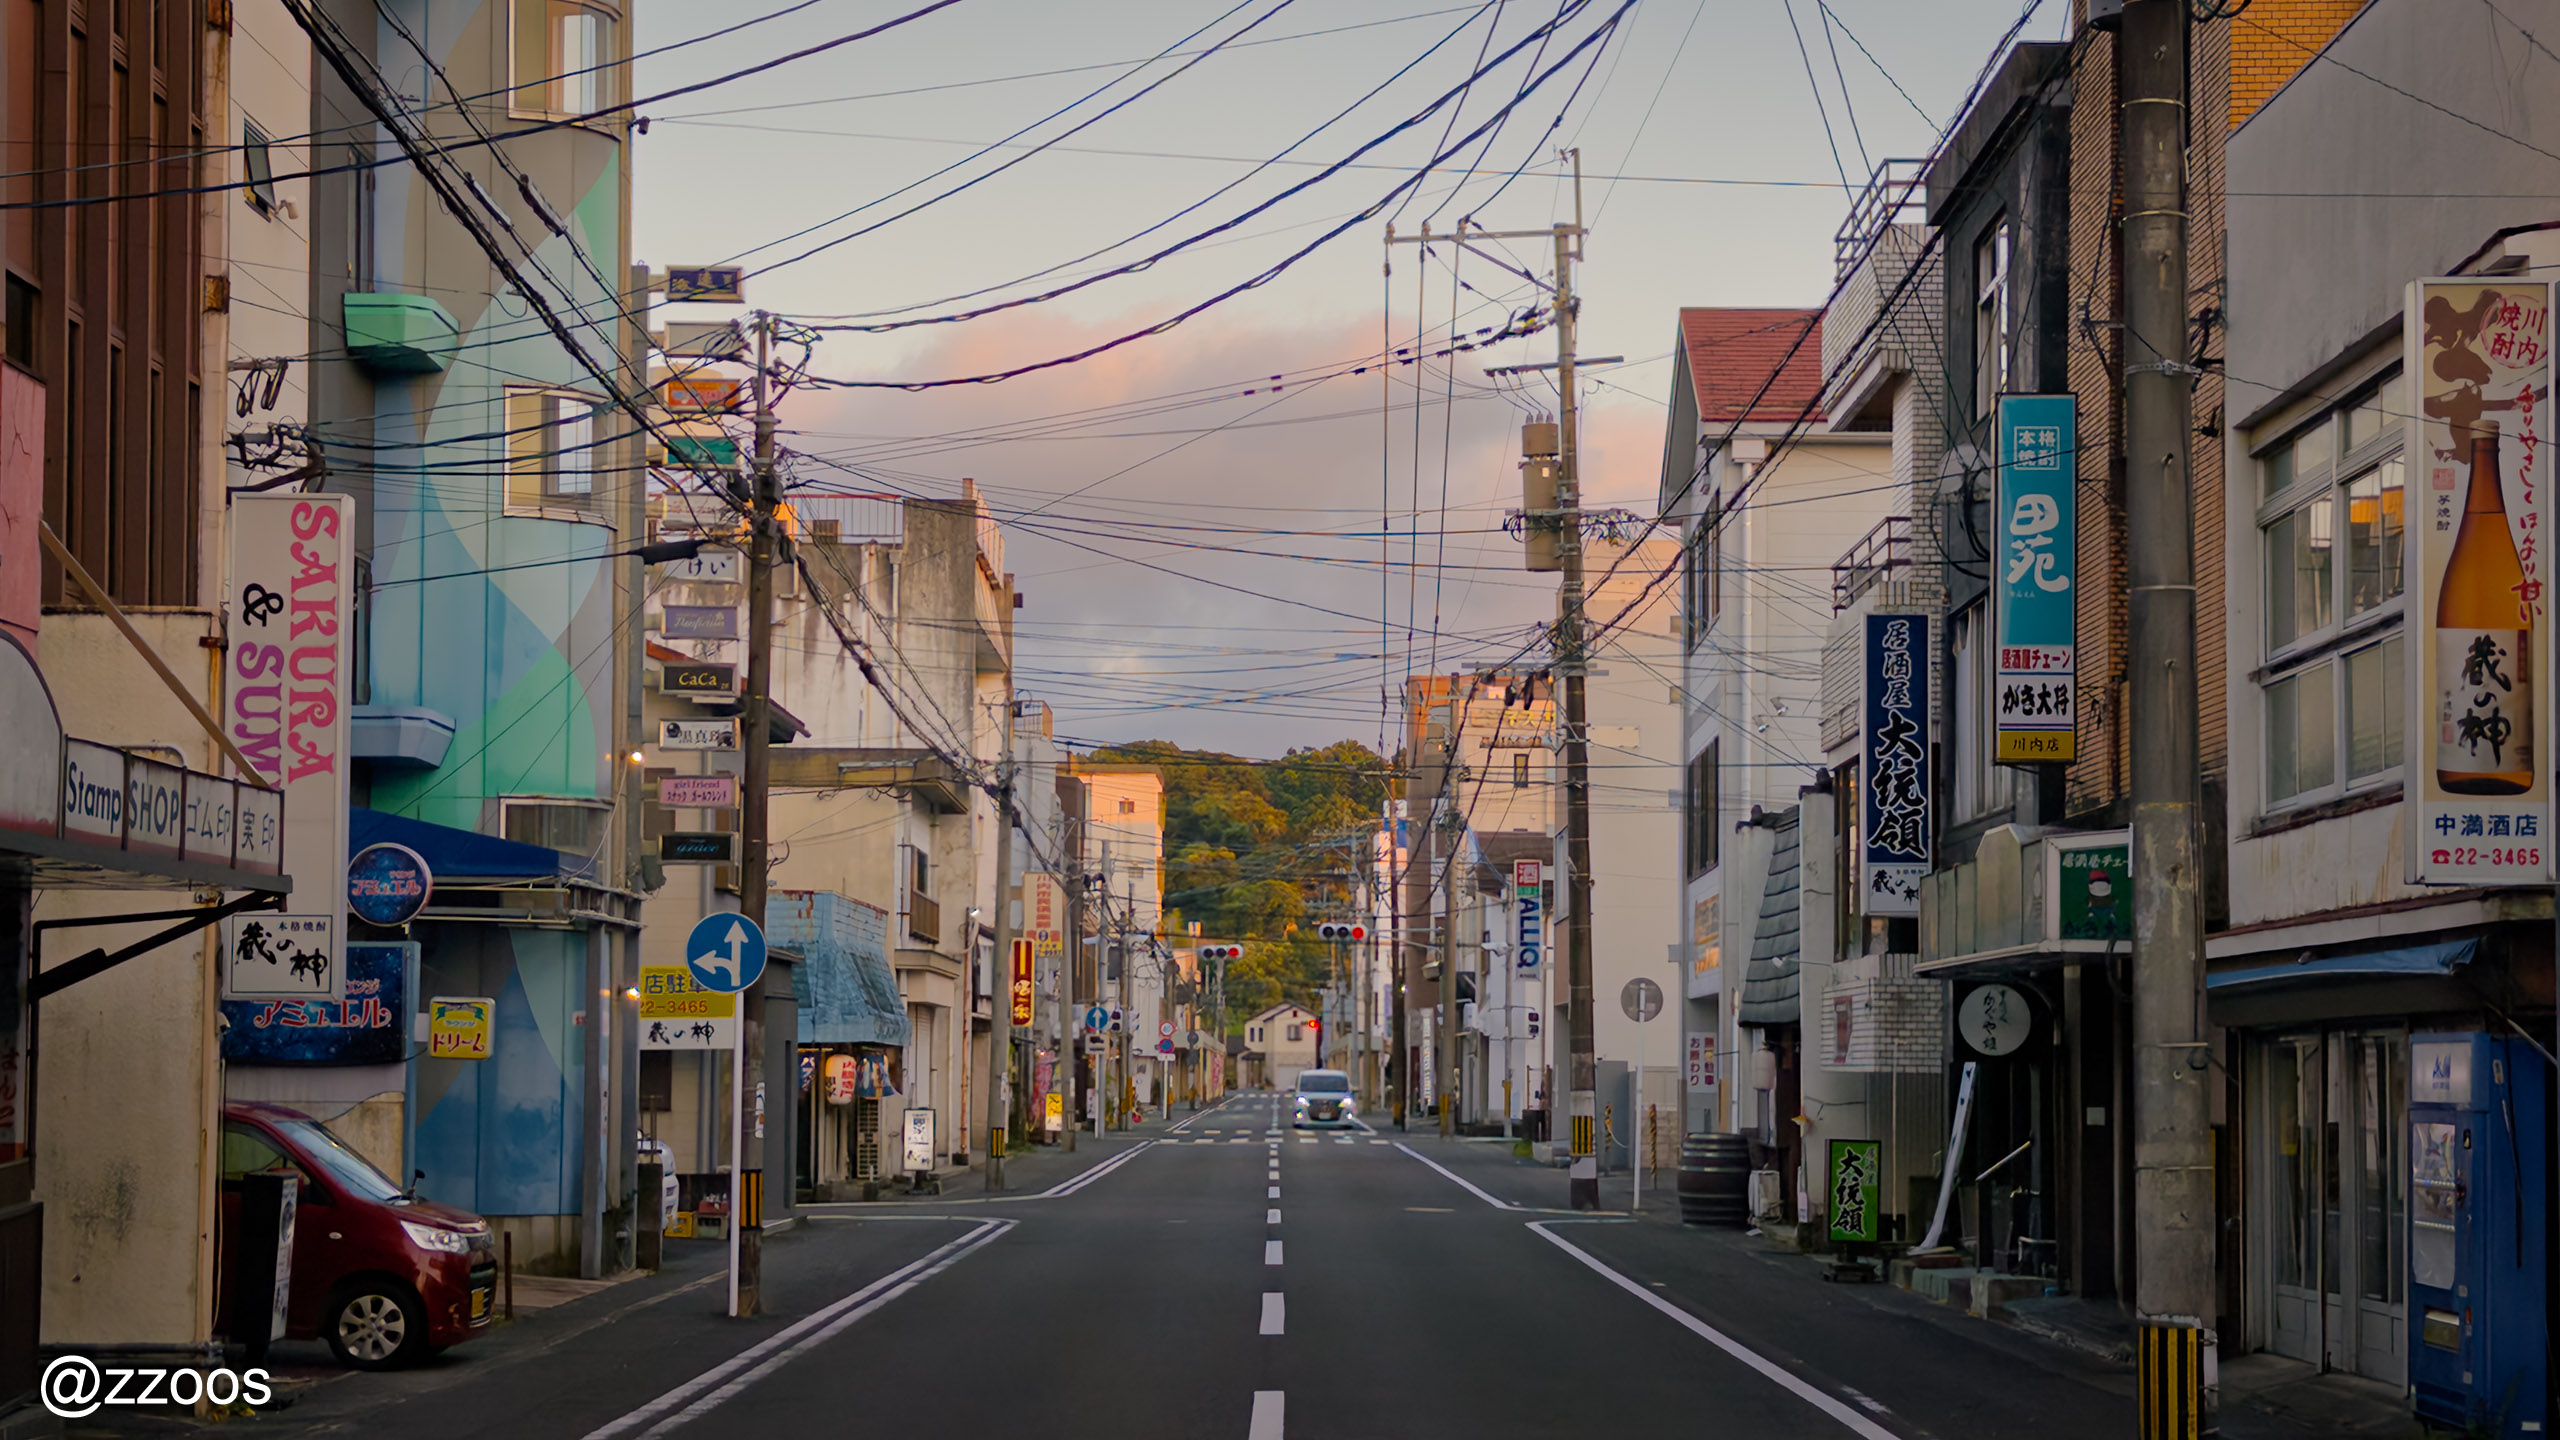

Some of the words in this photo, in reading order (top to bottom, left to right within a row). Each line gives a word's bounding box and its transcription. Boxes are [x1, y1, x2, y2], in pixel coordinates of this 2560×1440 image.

[2018, 430, 2055, 447] 本格
[2436, 495, 2451, 531] 芋焼酎
[243, 583, 284, 627] &
[287, 501, 339, 784] SAKURA
[1881, 619, 1913, 709] 居酒屋
[2001, 648, 2070, 669] 居酒屋チェーン
[678, 672, 718, 687] CaCa
[2458, 633, 2513, 769] 蔵の神
[234, 641, 285, 789] SUM
[2013, 738, 2059, 752] 川内店
[66, 761, 121, 834] Stamp
[128, 780, 180, 837] SHOP
[1867, 708, 1928, 860] 大統領
[187, 797, 231, 846] ゴム印
[2434, 812, 2539, 837] 中満酒店
[2453, 847, 2541, 866] 22-3465
[277, 920, 327, 933] 本格焼酎
[234, 920, 328, 988] 蔵の神
[432, 1032, 486, 1053] ドリーム
[1832, 1146, 1866, 1238] 大統領
